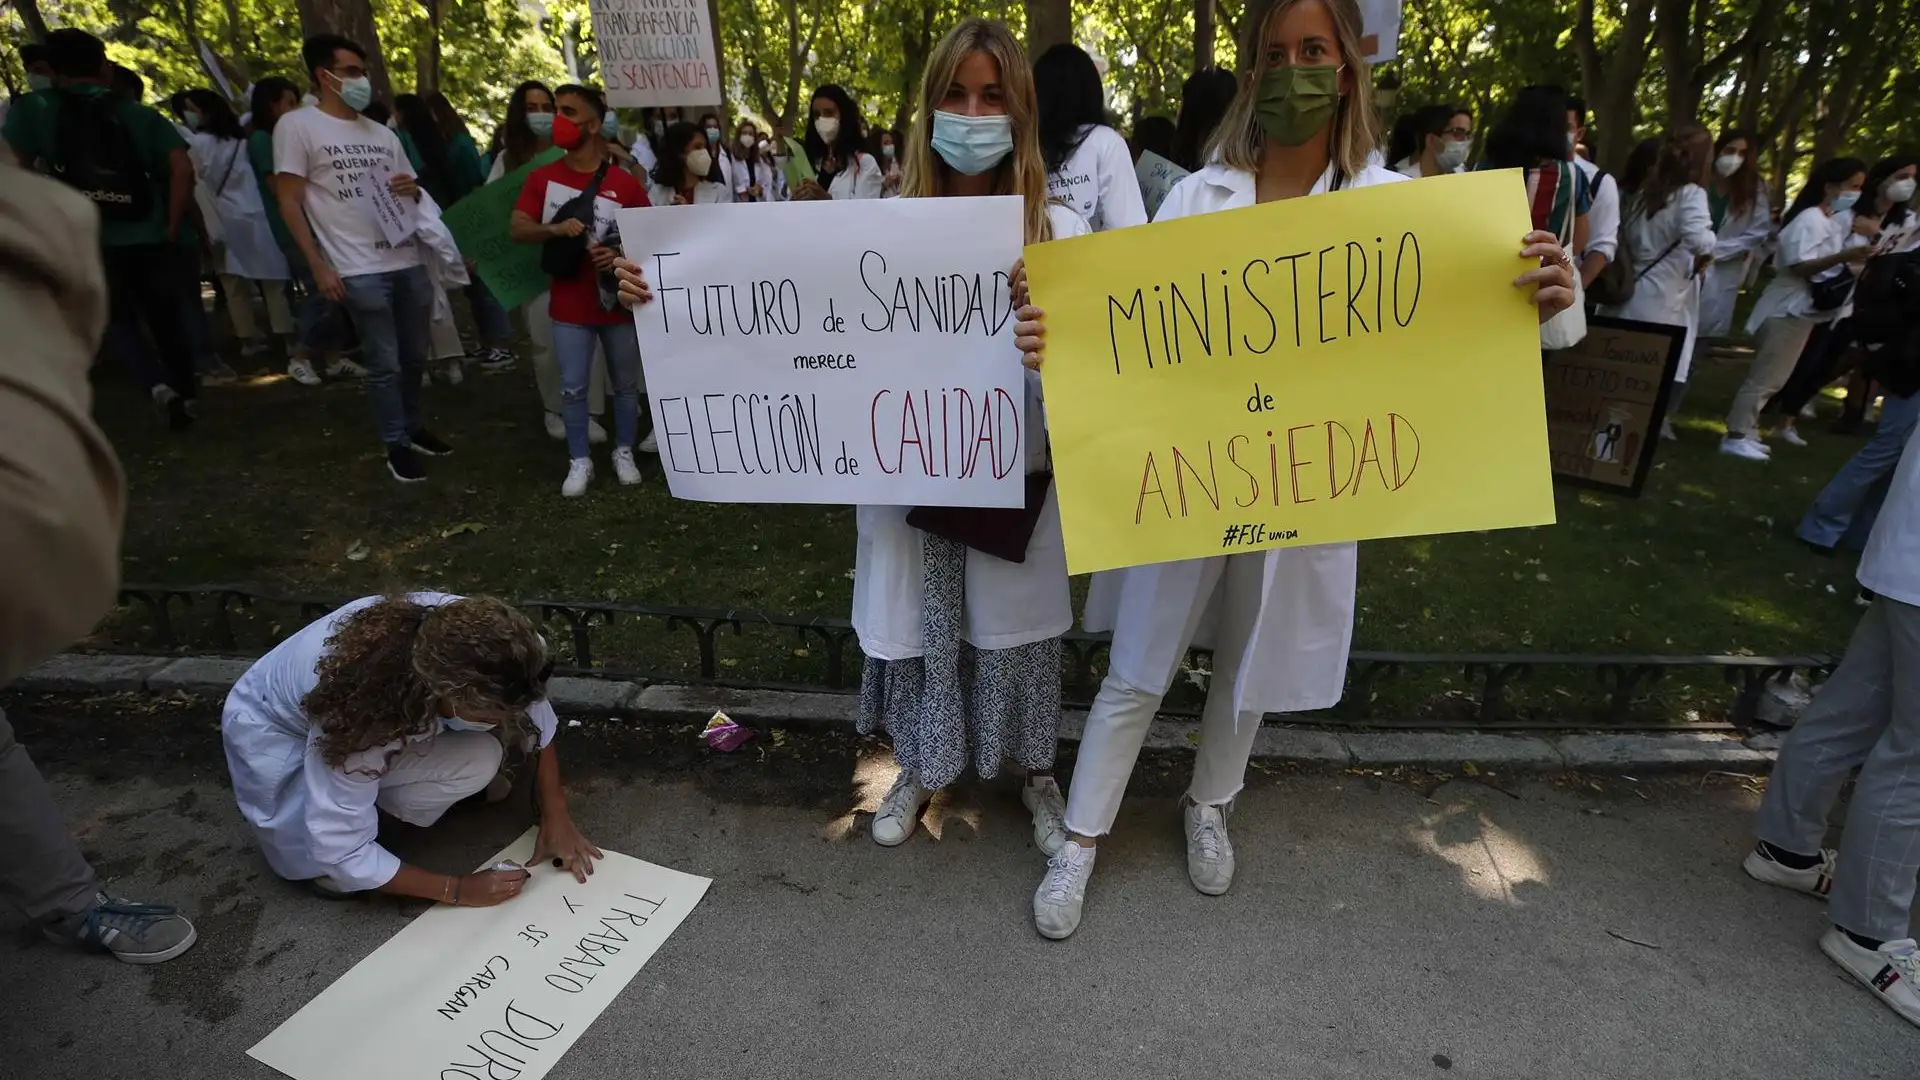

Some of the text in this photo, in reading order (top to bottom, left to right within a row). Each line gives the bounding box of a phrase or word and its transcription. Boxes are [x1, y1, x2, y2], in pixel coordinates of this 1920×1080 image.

[594, 11, 700, 36] TRANSPARENCIA
[621, 62, 712, 90] SENTENCIA
[324, 145, 343, 157] YA
[336, 173, 345, 185] Y
[1048, 173, 1091, 190] ETENCIA
[652, 252, 802, 337] FUTURO
[822, 297, 846, 334] de
[1246, 382, 1276, 413] de
[834, 440, 861, 476] de
[517, 924, 549, 948] SE
[544, 893, 667, 993] TRABAJO
[436, 955, 511, 1021] CARGAN
